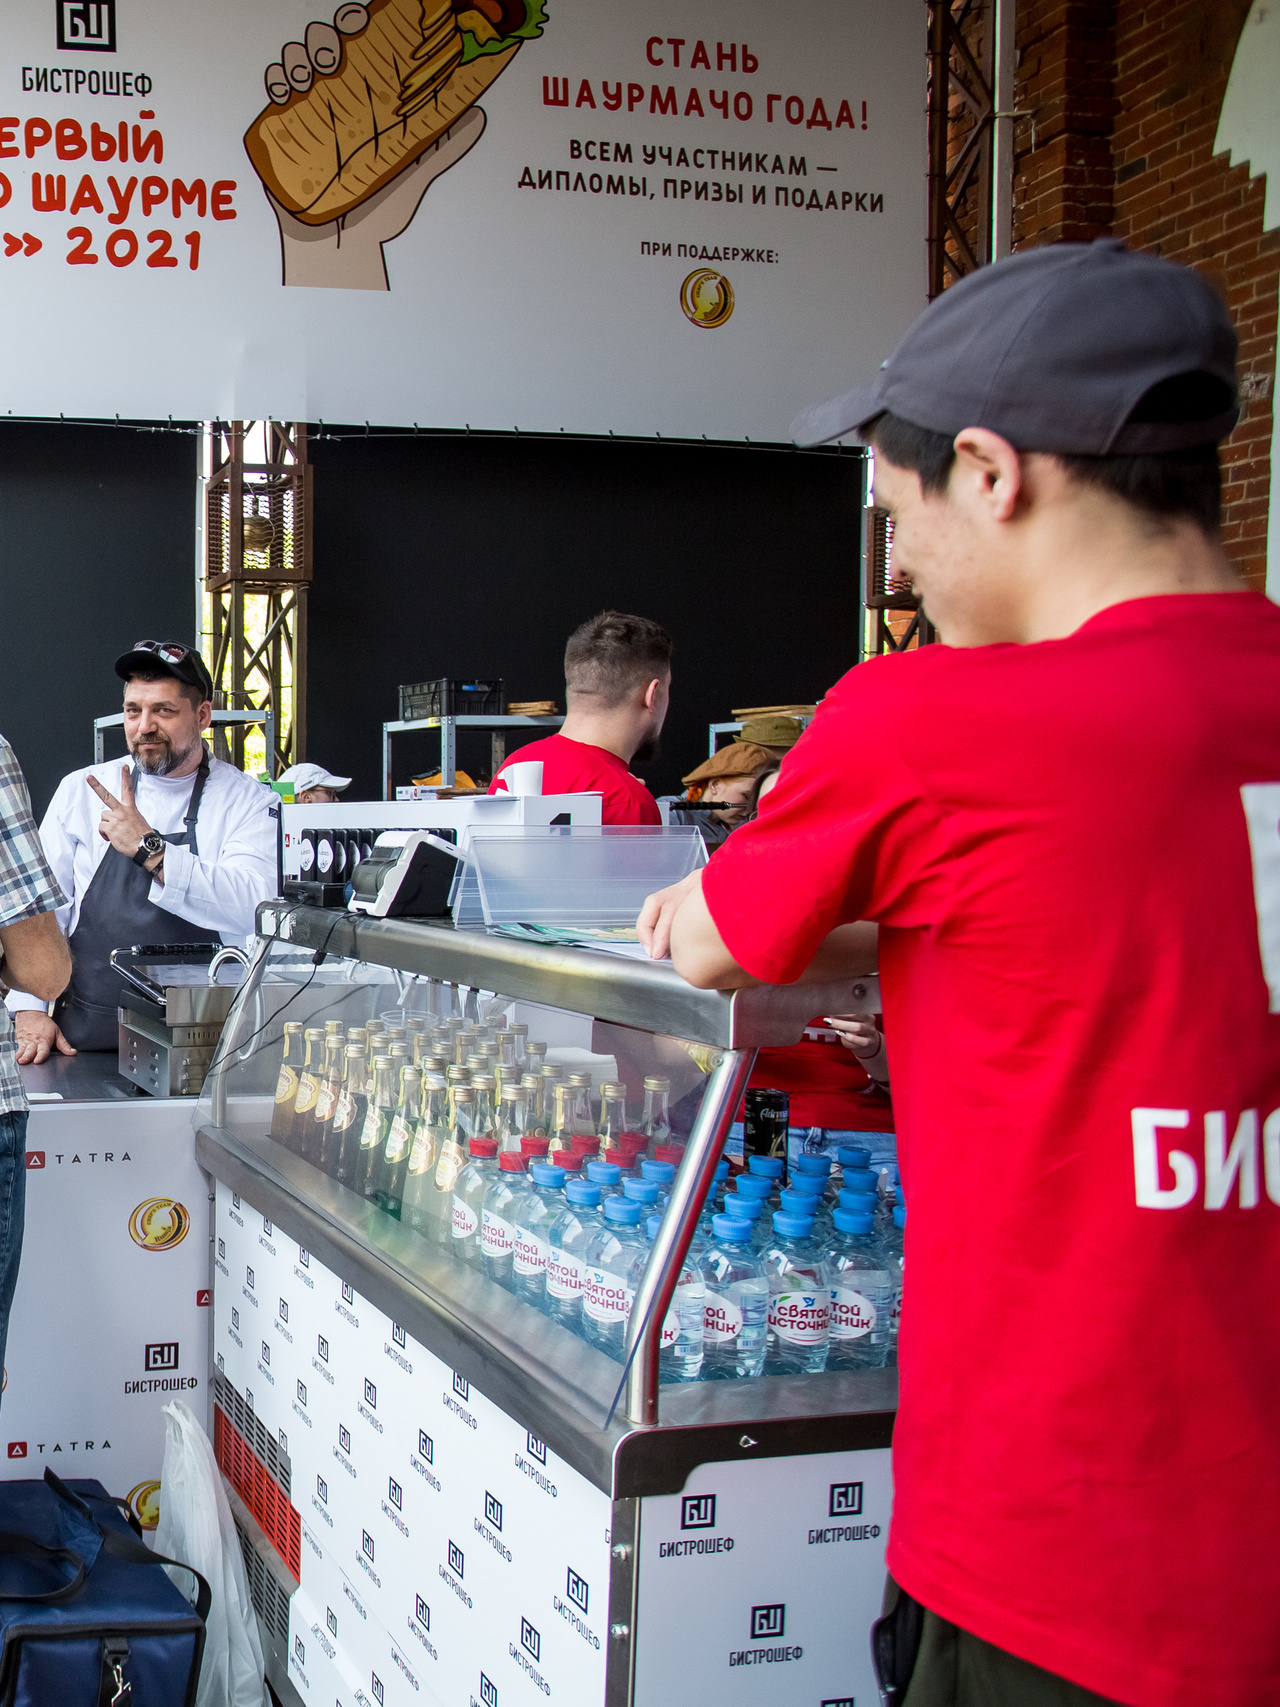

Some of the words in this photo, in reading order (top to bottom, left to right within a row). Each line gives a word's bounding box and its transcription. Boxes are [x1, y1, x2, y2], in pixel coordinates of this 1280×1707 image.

[645, 36, 759, 75] СТАНЬ
[22, 66, 153, 97] БИСТРОШЕФ
[542, 76, 754, 122] ШАУРМАЧО
[765, 92, 869, 131] ГОДА!
[569, 139, 633, 165] ВСЕМ
[642, 144, 808, 177] УЧАСТНИКАМ
[31, 172, 238, 224] ШАУРМЕ
[517, 165, 656, 201] ДИПЛОМЫ,
[662, 178, 744, 206] ПРИЗЫ
[751, 182, 767, 207] И
[774, 183, 885, 214] ПОДАРКИ
[65, 226, 202, 271] 2021
[640, 241, 672, 257] ПРИ
[677, 244, 780, 264] ПОДДЕРЖКЕ:
[55, 1151, 132, 1165] TATRA
[124, 1376, 198, 1394] БИСТРОШЕФ
[443, 1393, 478, 1430] БИСТРОШЕФ
[36, 1439, 112, 1453] TATRA
[515, 1453, 558, 1498] БИСТРОШЕФ
[474, 1518, 513, 1563] БИСТРОШЕФ
[659, 1537, 734, 1558] БИСТРОШЕФ
[808, 1524, 881, 1545] БИСТРОШЕФ
[438, 1564, 473, 1609] БИСТРОШЕФ
[553, 1595, 601, 1650] БИСТРОШЕФ
[509, 1642, 551, 1697] БИСТРОШЕФ
[729, 1646, 803, 1667] БИСТРОШЕФ
